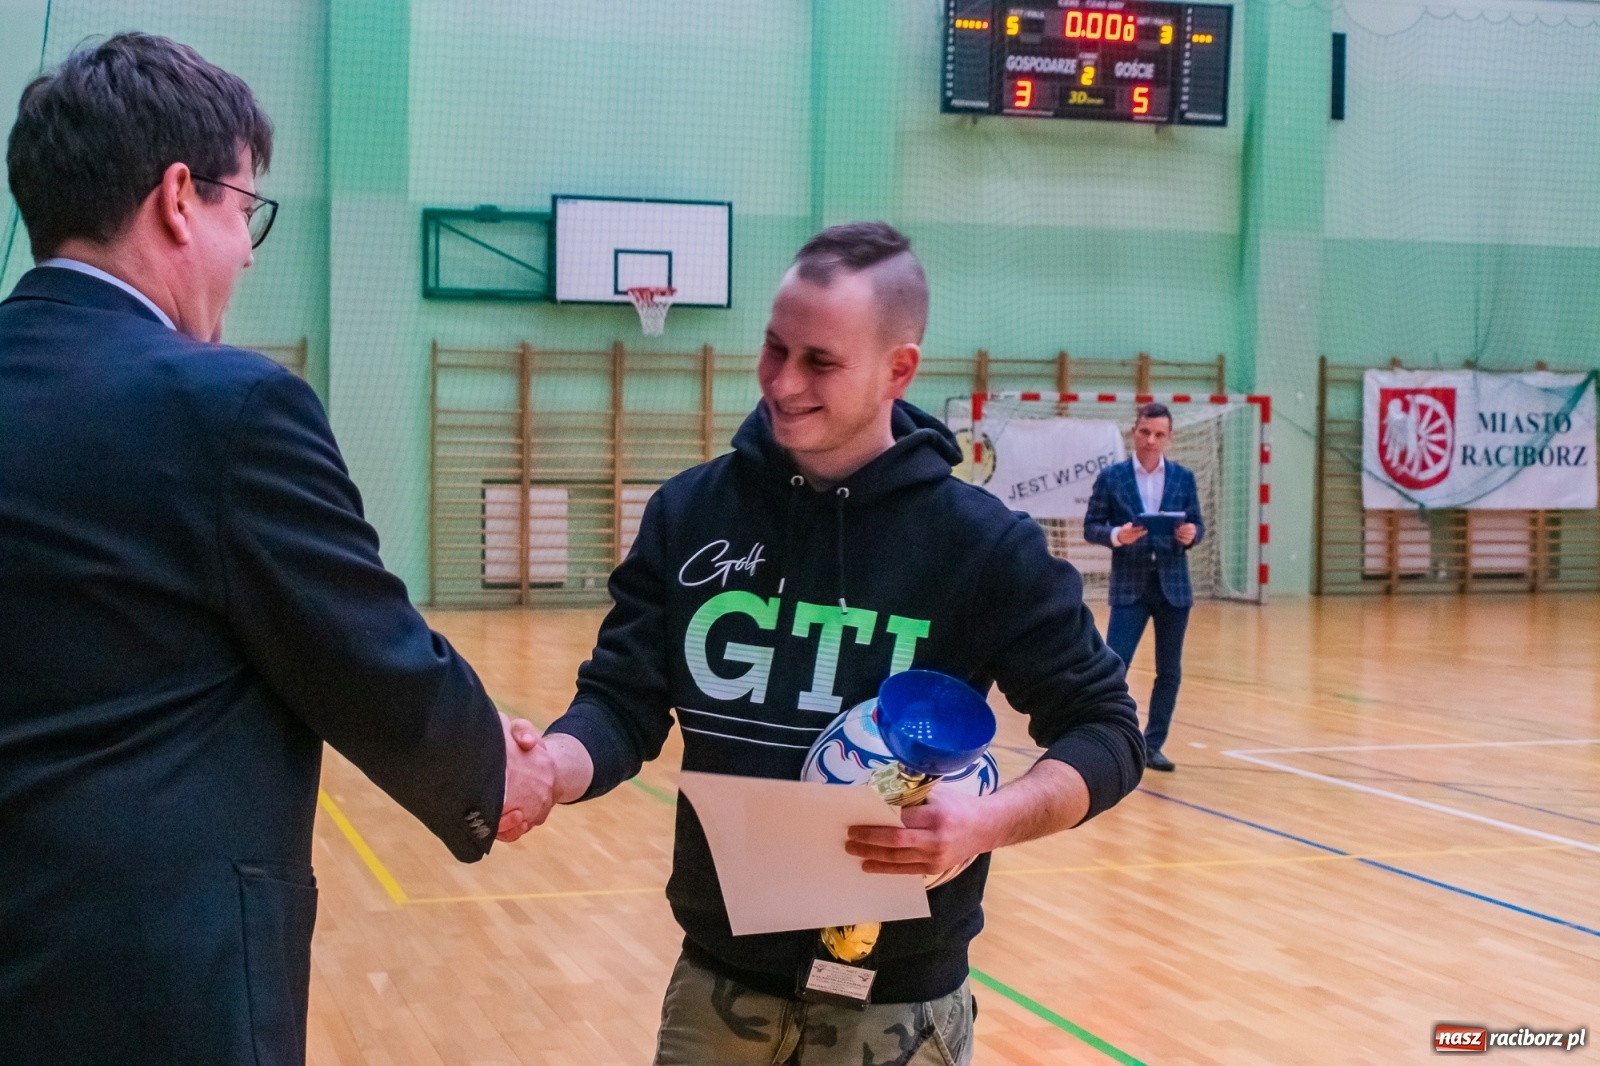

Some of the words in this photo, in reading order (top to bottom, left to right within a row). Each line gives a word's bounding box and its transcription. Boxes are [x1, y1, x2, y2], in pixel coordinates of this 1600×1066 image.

[1006, 15, 1020, 36] 5
[1160, 25, 1173, 45] 3
[1006, 55, 1078, 75] GOSPODARZE
[1081, 66, 1095, 86] 2
[1114, 58, 1155, 80] GOŚCIE
[1014, 80, 1032, 108] 3
[1132, 87, 1149, 114] 5
[1476, 411, 1572, 434] MIASTO
[1008, 474, 1049, 500] JEST
[1053, 469, 1071, 485] W
[678, 539, 766, 587] Golf
